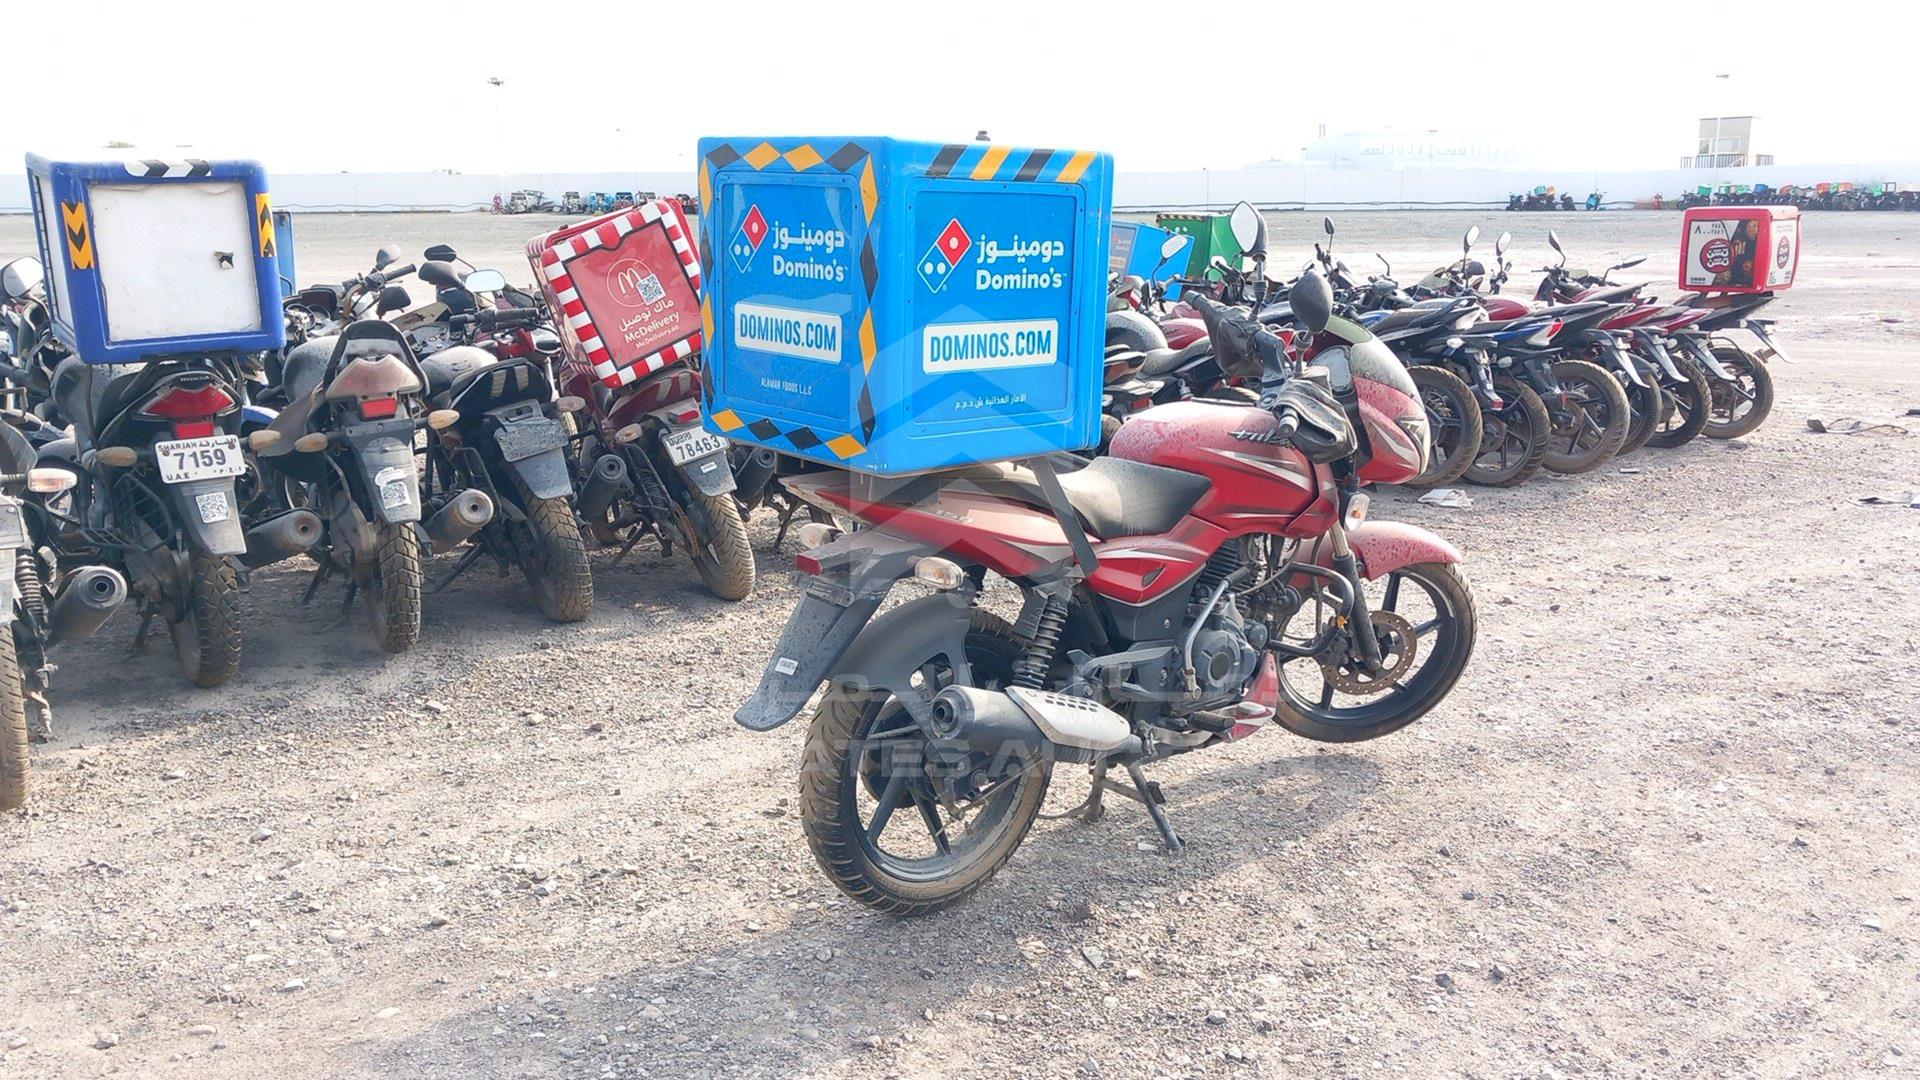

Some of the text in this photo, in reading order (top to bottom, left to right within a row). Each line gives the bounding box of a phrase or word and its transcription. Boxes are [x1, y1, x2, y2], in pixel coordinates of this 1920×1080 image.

[772, 220, 845, 254] دومينوز
[976, 233, 1065, 264] دومينوز
[772, 254, 845, 282] Domino's
[975, 266, 1063, 291] Domino's
[624, 312, 680, 344] McDelivery
[740, 313, 837, 352] DOMINOS.COM
[930, 330, 1051, 362] DOMINOS.COM
[173, 448, 227, 471] 7159
[676, 434, 721, 460] 78463
